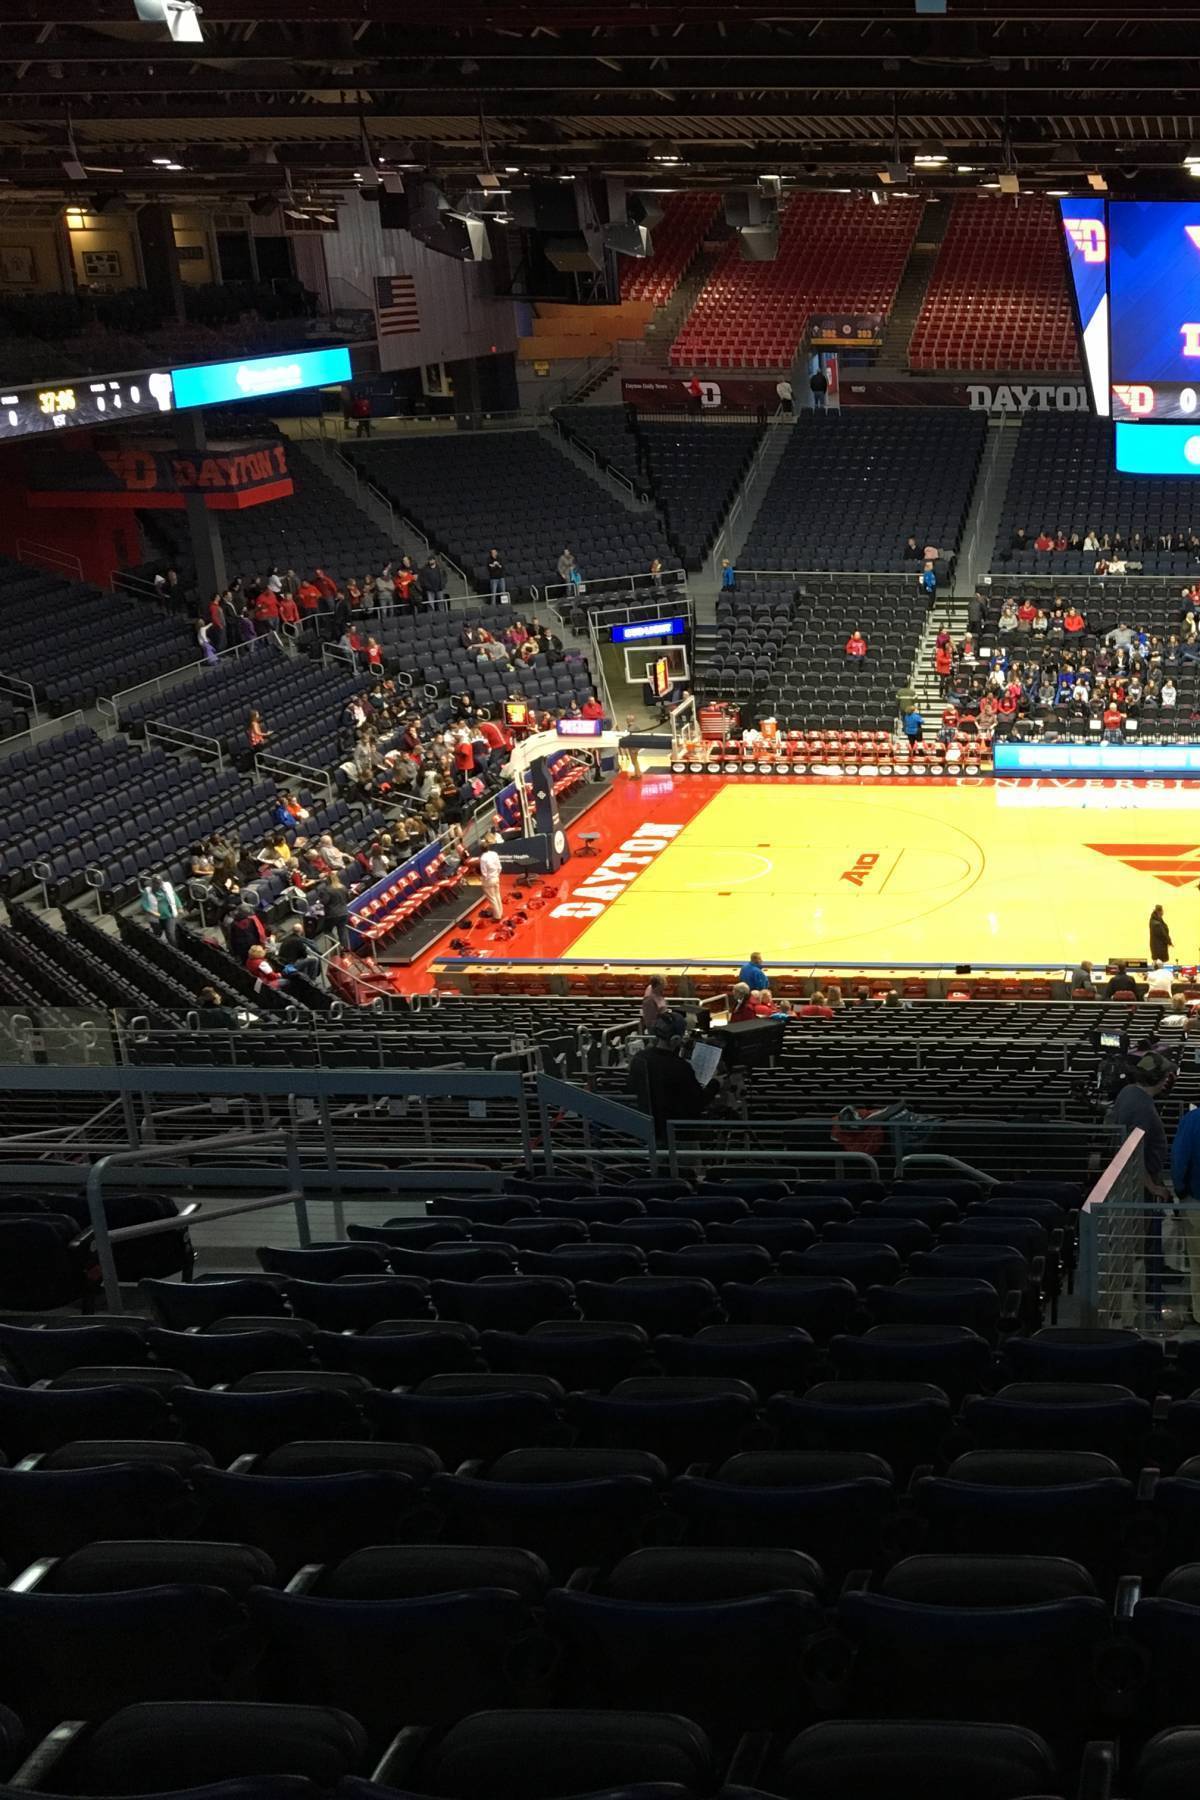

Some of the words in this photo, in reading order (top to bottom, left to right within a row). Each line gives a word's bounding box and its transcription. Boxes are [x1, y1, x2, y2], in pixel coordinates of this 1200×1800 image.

[1180, 387, 1197, 413] 0
[171, 449, 274, 488] DAYTON
[549, 822, 685, 919] DAYTON
[838, 853, 881, 887] A10
